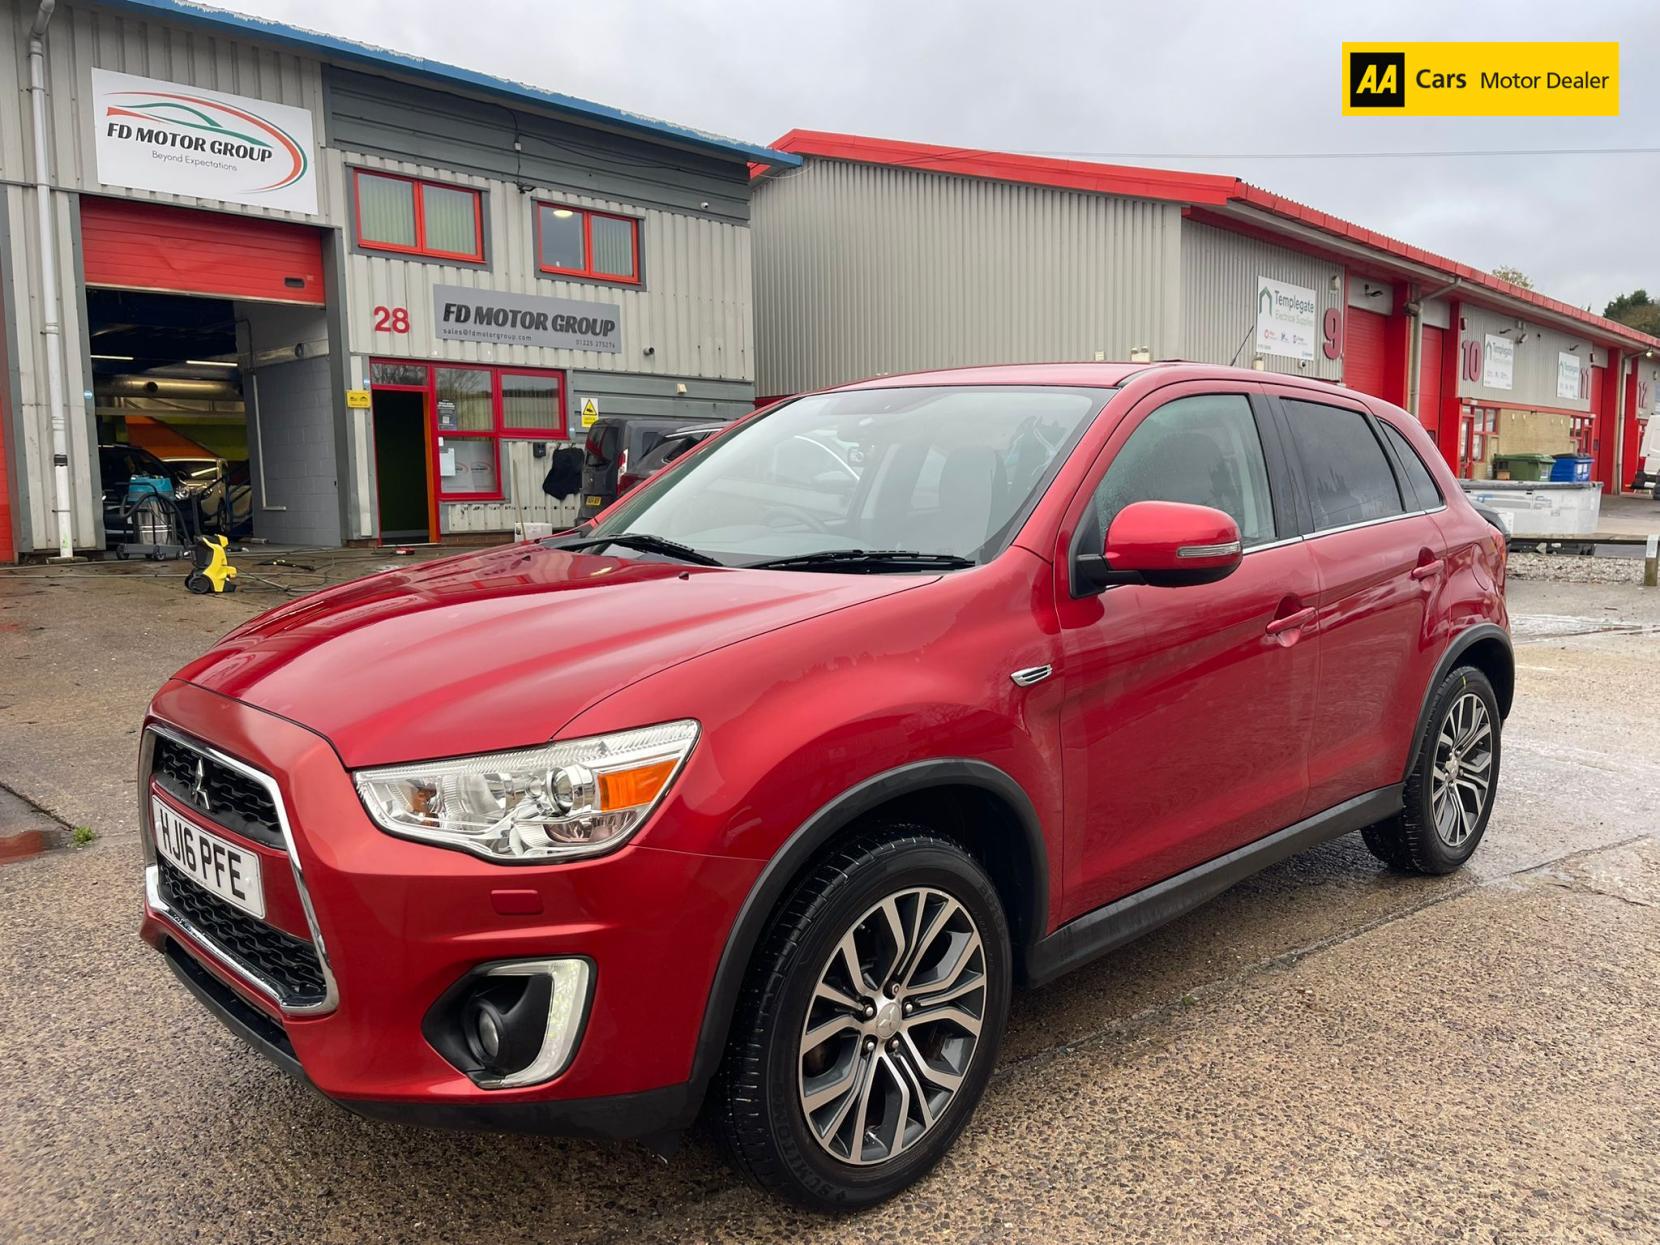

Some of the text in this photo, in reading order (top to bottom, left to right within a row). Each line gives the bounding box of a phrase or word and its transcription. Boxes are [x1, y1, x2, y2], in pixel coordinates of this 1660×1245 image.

[107, 122, 273, 163] FD MOTOR GROUP
[152, 150, 238, 171] Beyond Expectations
[1274, 289, 1315, 315] Templegate
[373, 305, 411, 334] 28
[442, 302, 616, 338] FD MOTOR GROUP
[1323, 307, 1342, 360] 9
[1461, 339, 1482, 382] 10
[1580, 367, 1590, 400] 11
[1638, 381, 1648, 409] 12
[160, 808, 247, 902] HJ16 PFE
